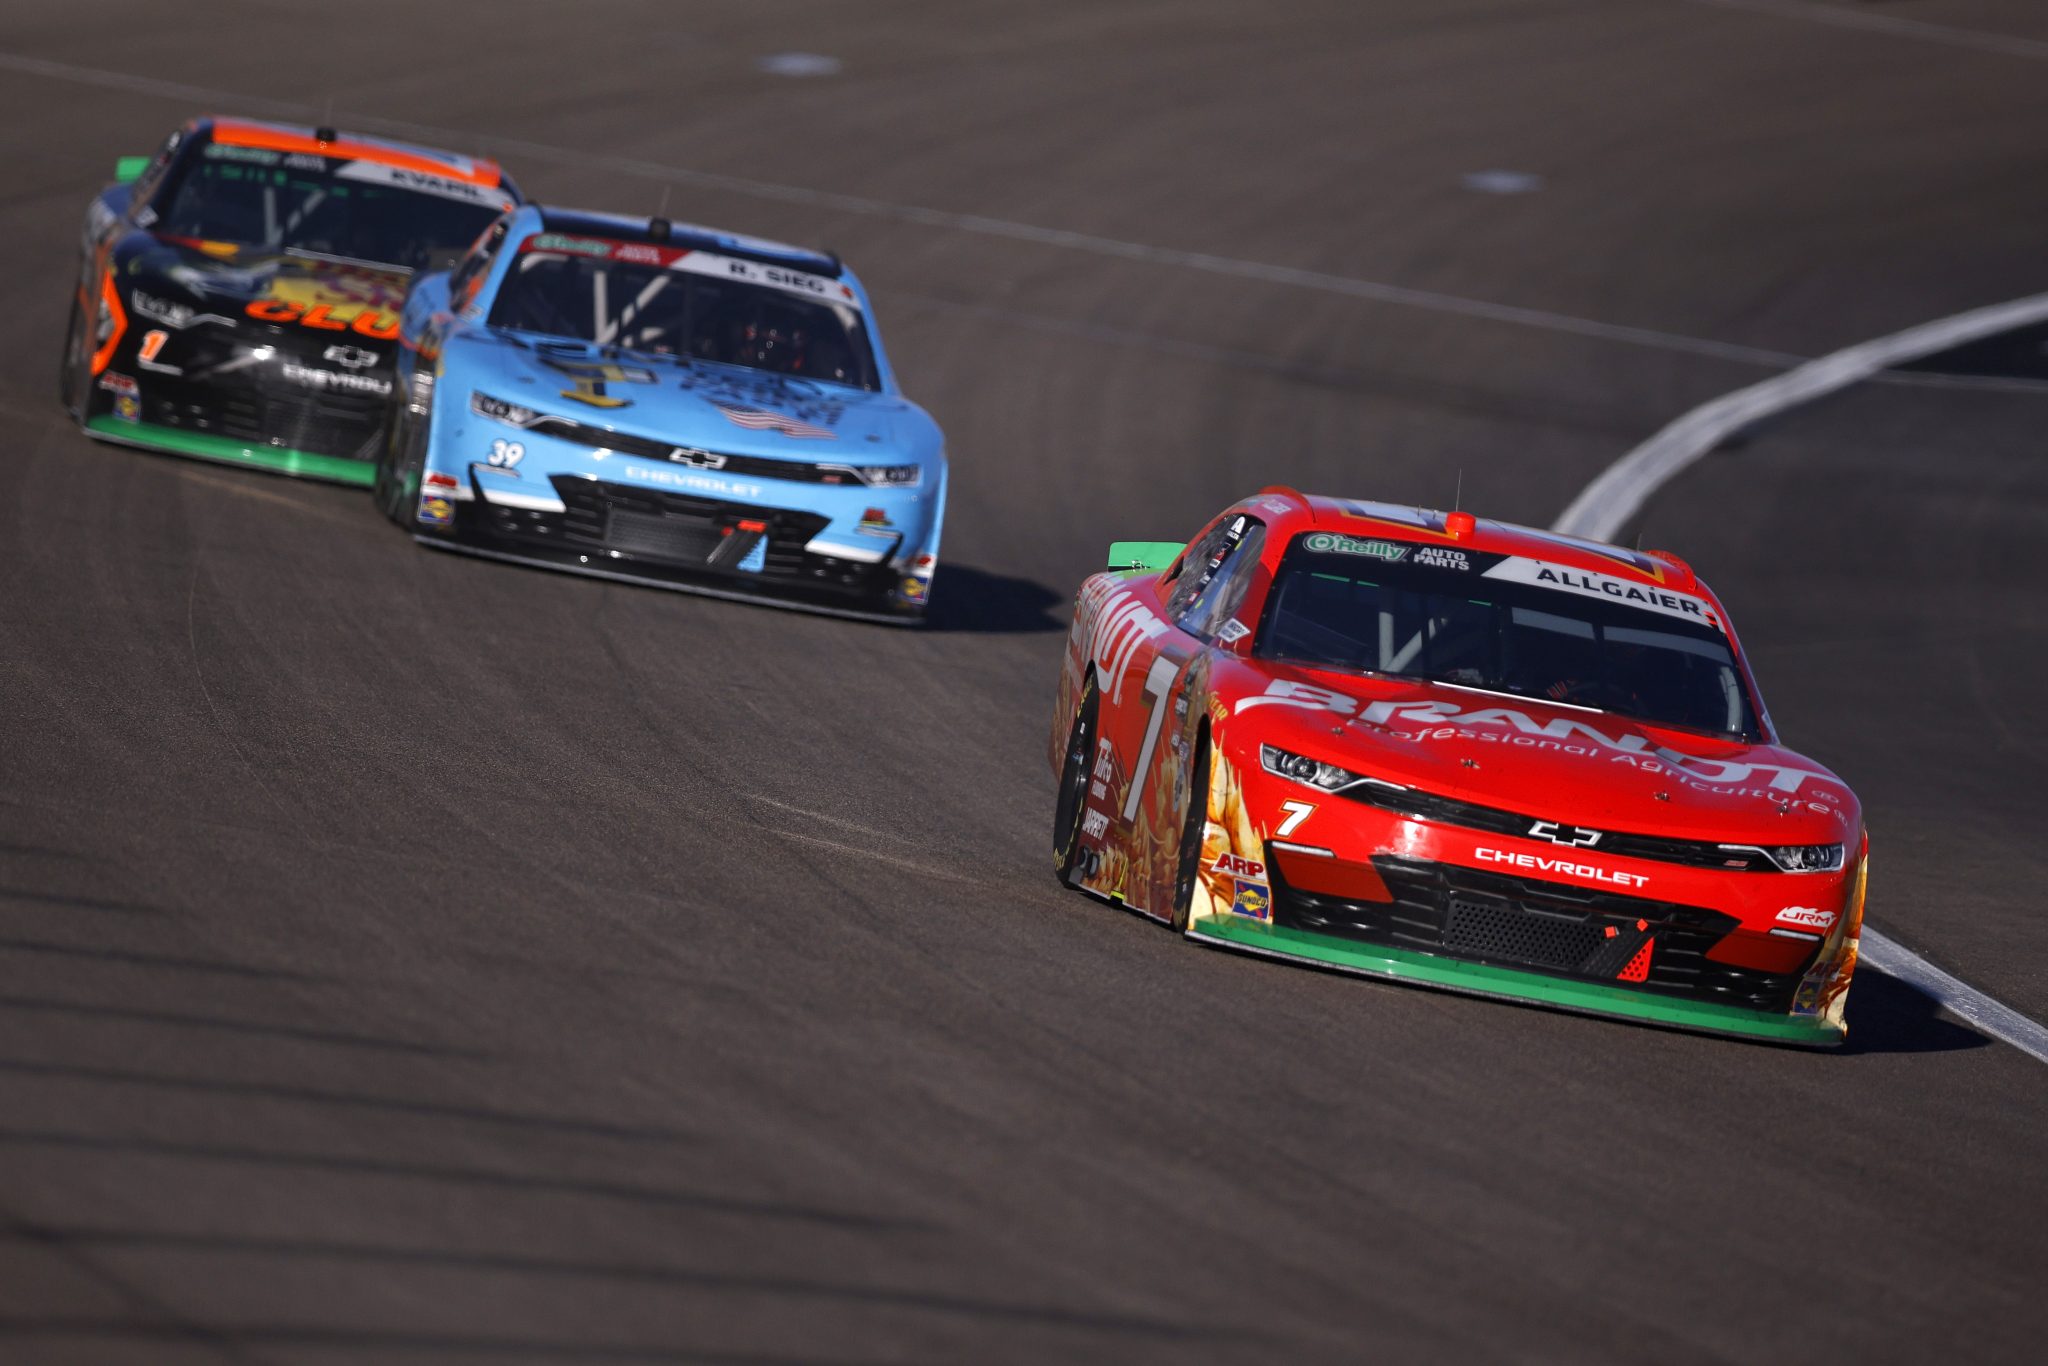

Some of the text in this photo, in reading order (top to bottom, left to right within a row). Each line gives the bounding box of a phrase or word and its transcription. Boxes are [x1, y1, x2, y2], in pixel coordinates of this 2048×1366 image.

[766, 268, 826, 293] SIEG
[138, 329, 169, 363] 1
[486, 438, 526, 470] 39
[625, 465, 763, 498] CHEVROLET
[1305, 533, 1408, 562] O'Reilly
[1413, 554, 1470, 571] PARTS
[1421, 547, 1466, 561] AUTO
[1536, 567, 1702, 616] ALLGAIER
[1123, 655, 1180, 822] 7
[1234, 678, 1848, 793] BRANDT
[1346, 718, 1598, 758] Professional
[1275, 799, 1316, 838] 7
[1215, 853, 1264, 877] ARP
[1475, 847, 1650, 888] CHEVROLET
[1238, 893, 1268, 908] SUNOCO
[1782, 911, 1835, 926] JRM
